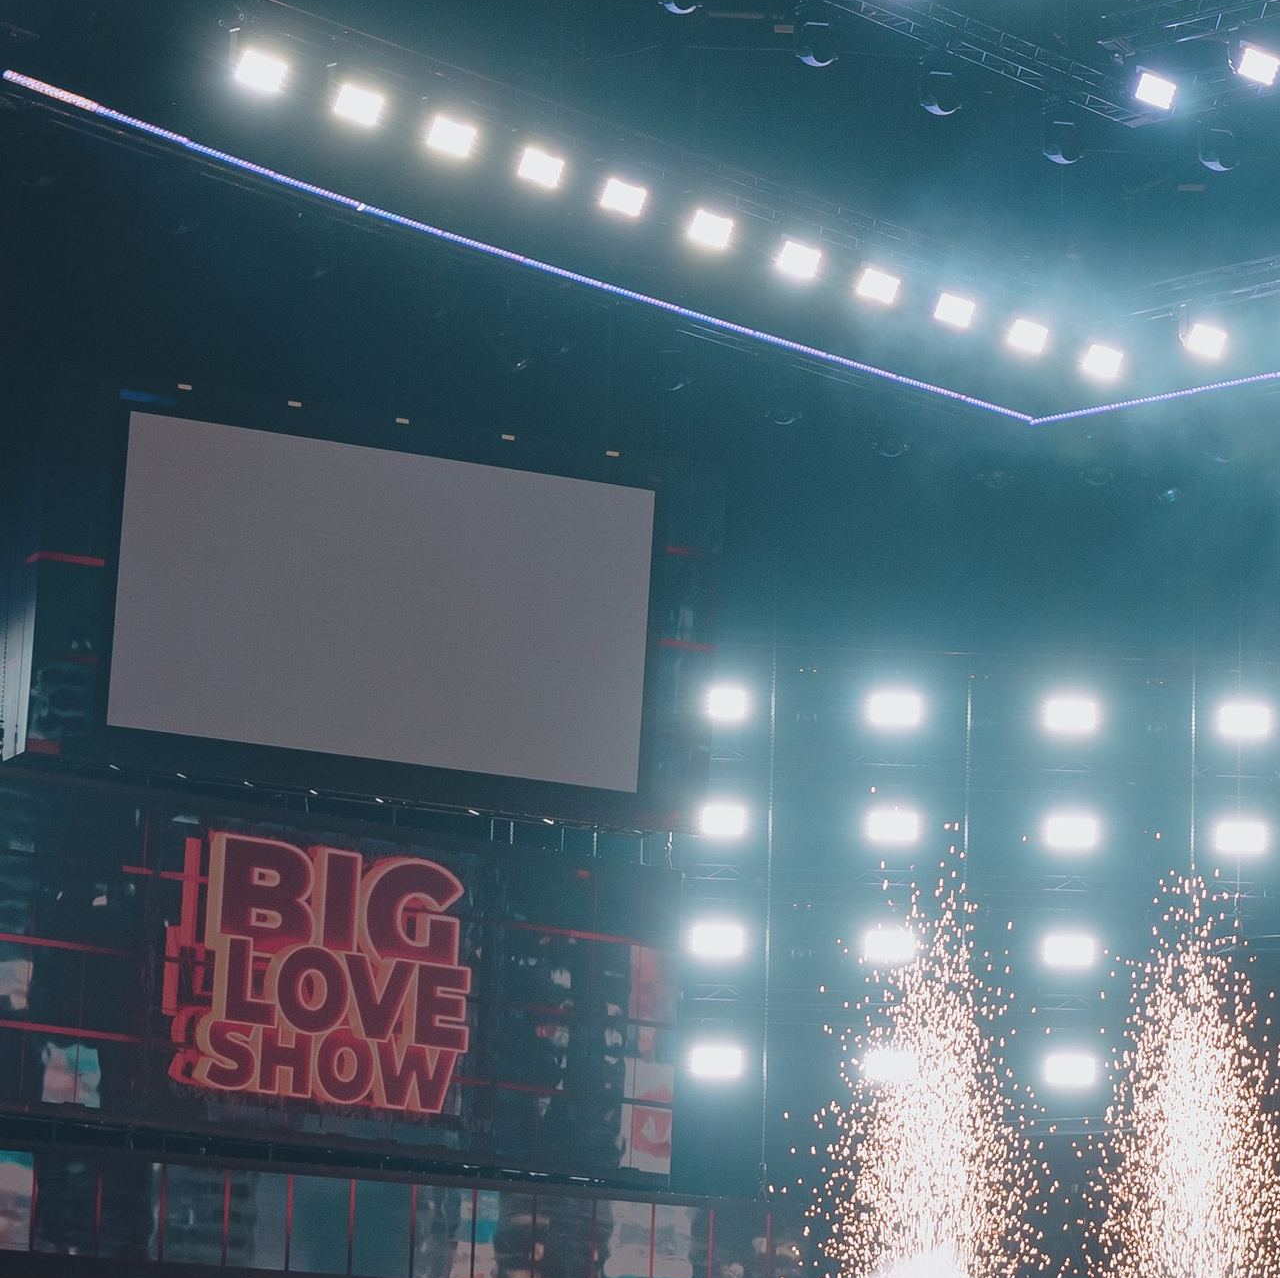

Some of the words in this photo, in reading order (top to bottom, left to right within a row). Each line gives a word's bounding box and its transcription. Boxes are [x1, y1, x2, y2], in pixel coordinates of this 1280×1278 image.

[206, 832, 465, 965] BIG
[212, 935, 472, 1053] LOVE
[194, 1020, 460, 1114] SHOW
